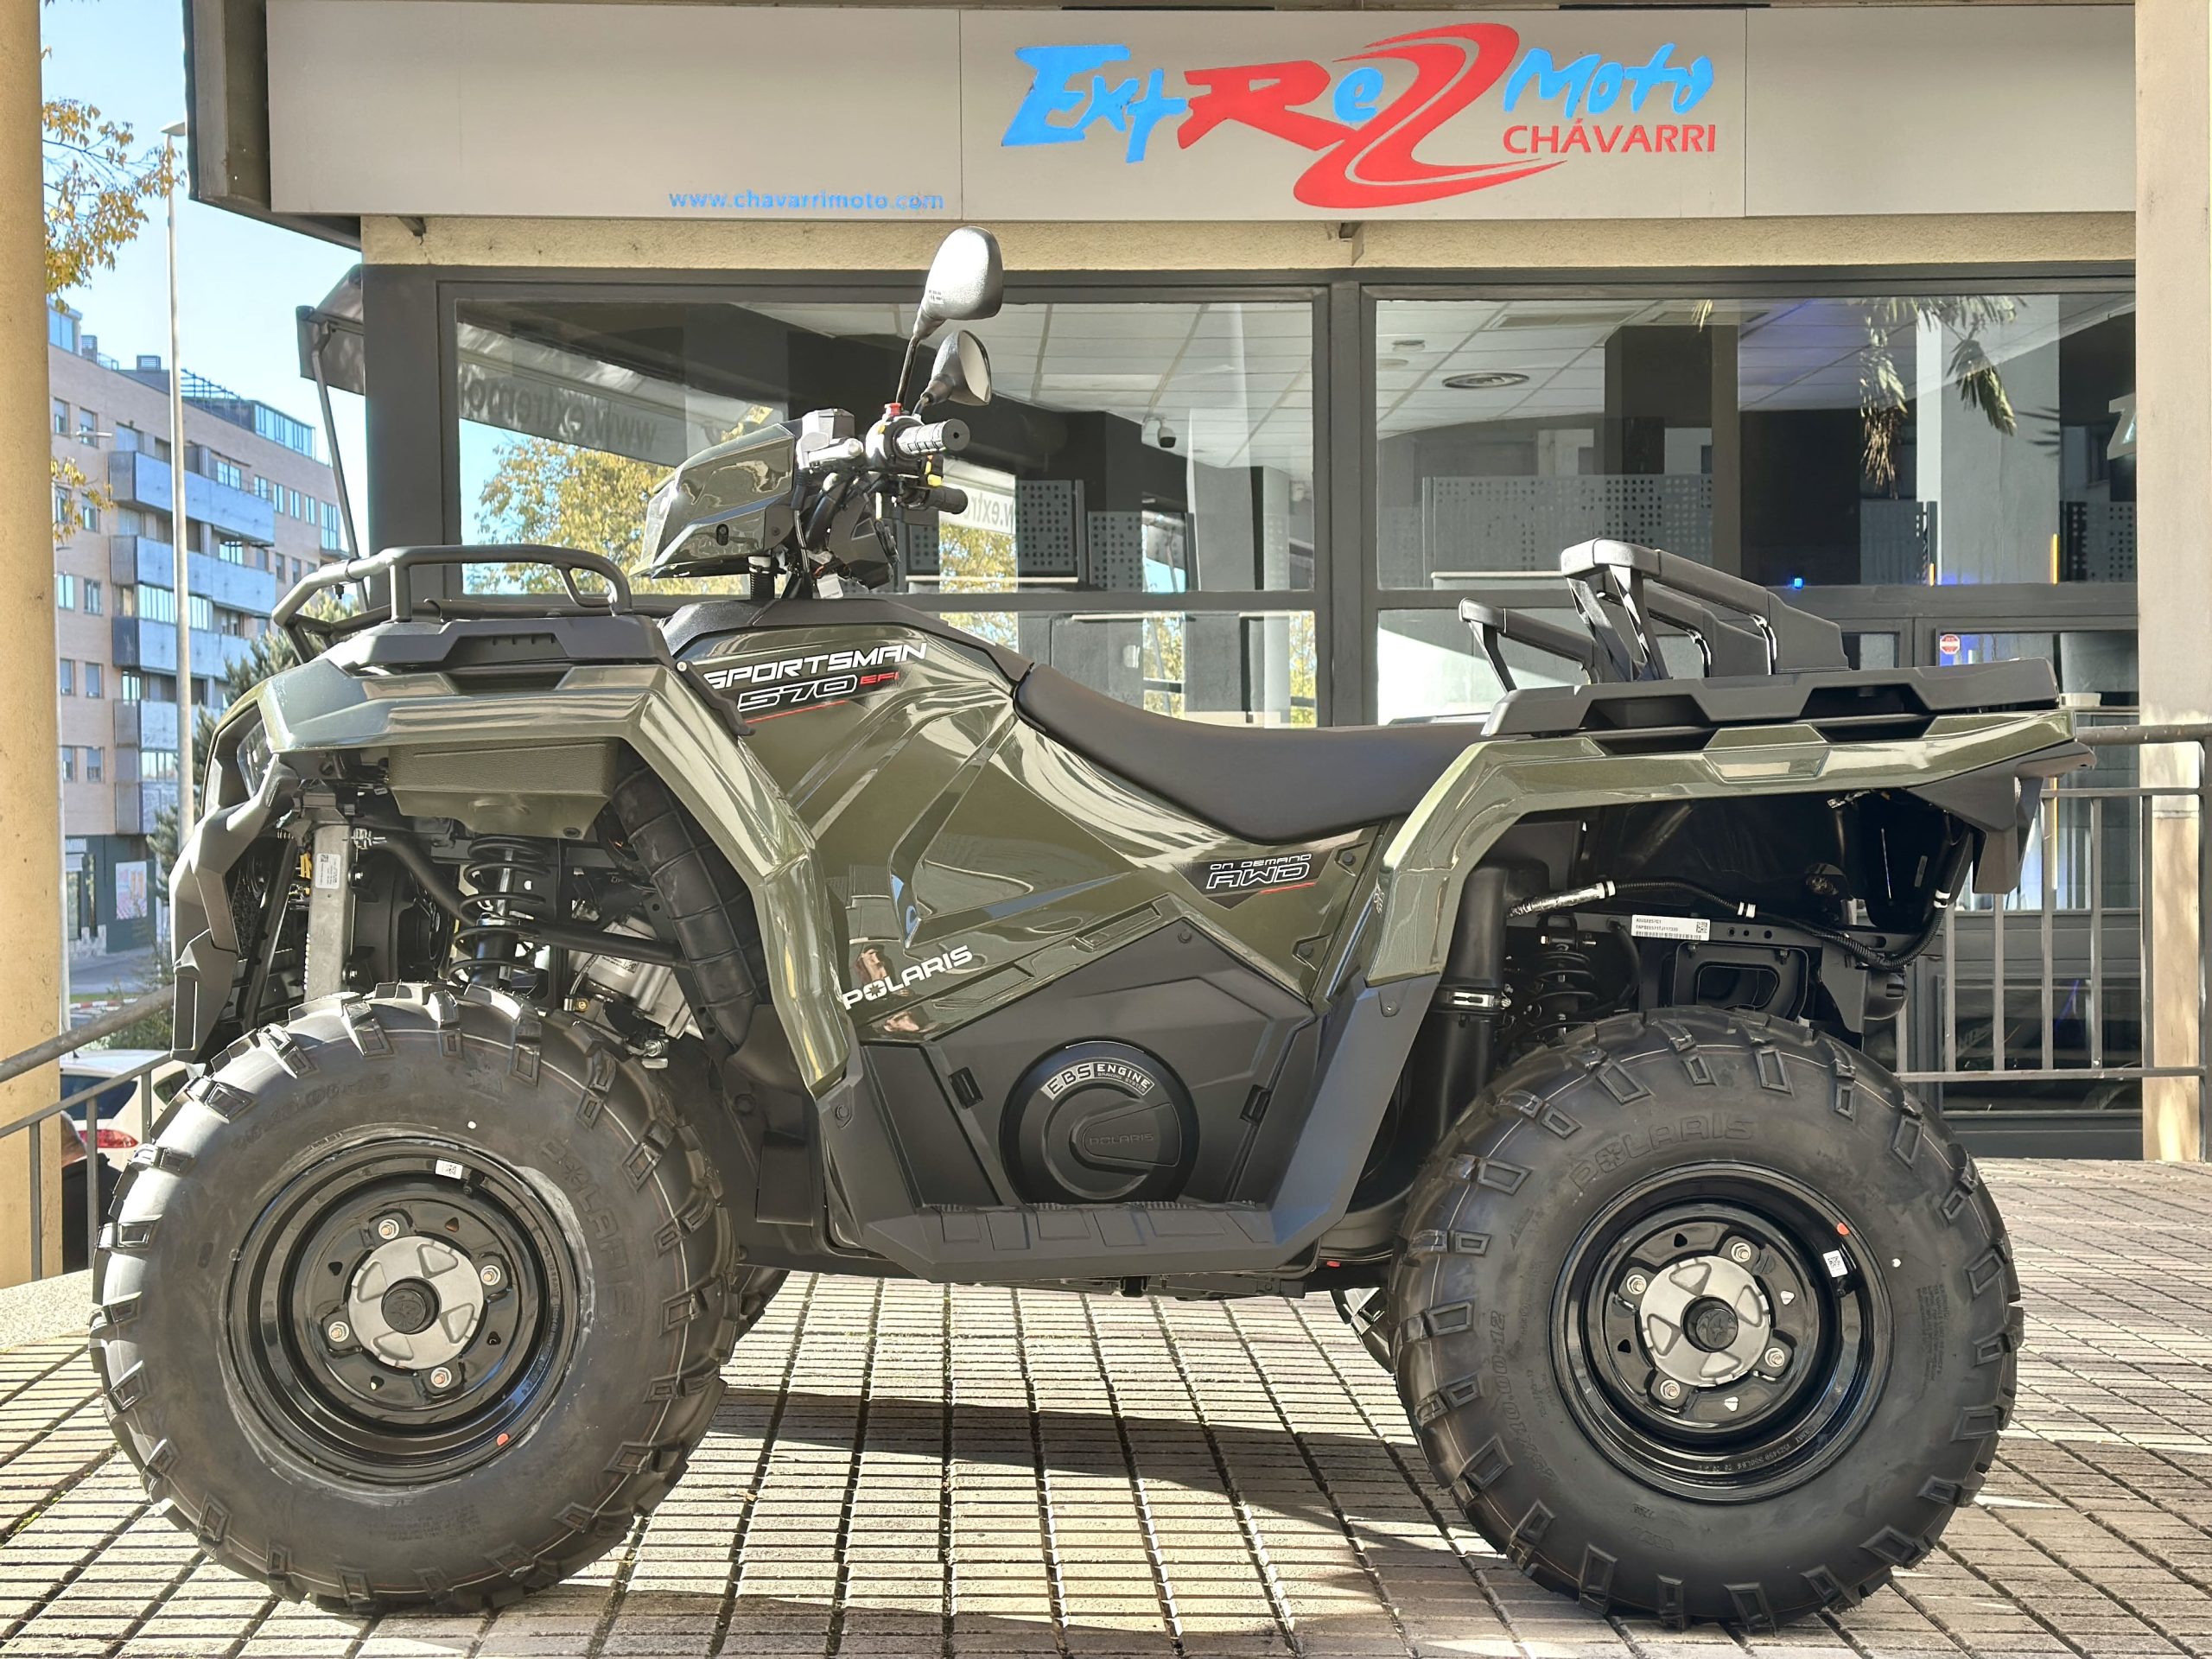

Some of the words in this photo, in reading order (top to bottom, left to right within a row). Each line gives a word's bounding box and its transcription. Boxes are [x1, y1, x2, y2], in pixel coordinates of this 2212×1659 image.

[1503, 118, 1715, 154] CHÁVARRI
[669, 188, 944, 209] www.chavarrimoto.com
[703, 642, 927, 690] SPORTSMAN
[737, 674, 858, 712] 570
[859, 671, 899, 686] EFI
[1205, 861, 1311, 890] AWD
[1210, 862, 1234, 871] ON
[1241, 854, 1313, 868] DEMAND
[842, 944, 973, 1011] POLARIS
[1046, 1065, 1090, 1095] EBS
[1096, 1064, 1151, 1090] ENGINE
[1089, 1132, 1155, 1146] POLARIS
[1568, 1112, 1755, 1192] POLARIS
